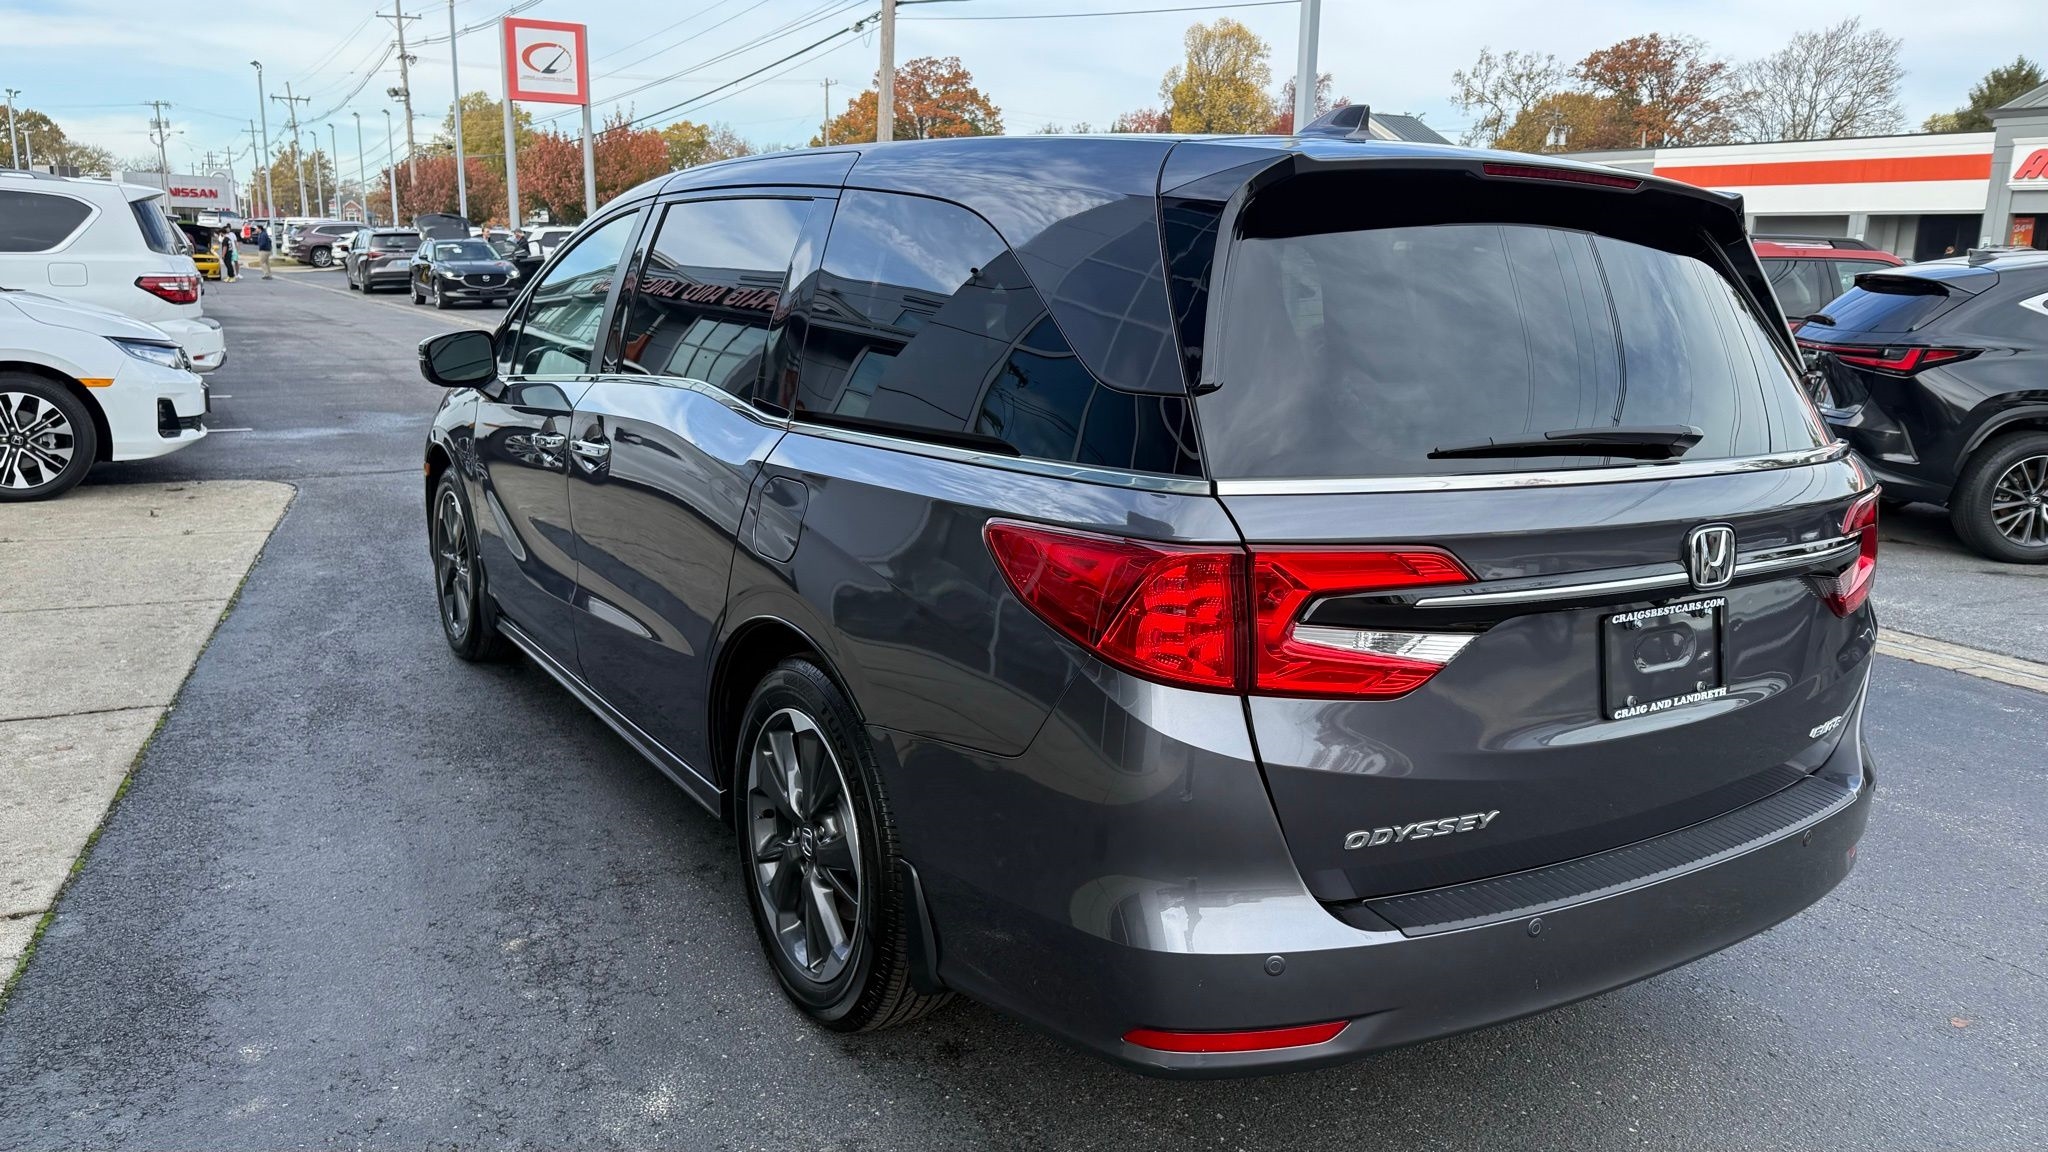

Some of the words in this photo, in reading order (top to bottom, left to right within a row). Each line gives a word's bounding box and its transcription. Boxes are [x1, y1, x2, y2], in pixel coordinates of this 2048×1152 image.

[169, 187, 218, 199] NISSAN
[1612, 598, 1726, 625] CRAIGSBESTCARS.COM
[1614, 705, 1648, 720] CRAIG
[1649, 700, 1672, 713] AND
[1674, 687, 1728, 707] LANDRETH
[1343, 809, 1500, 849] ODYSSEY
